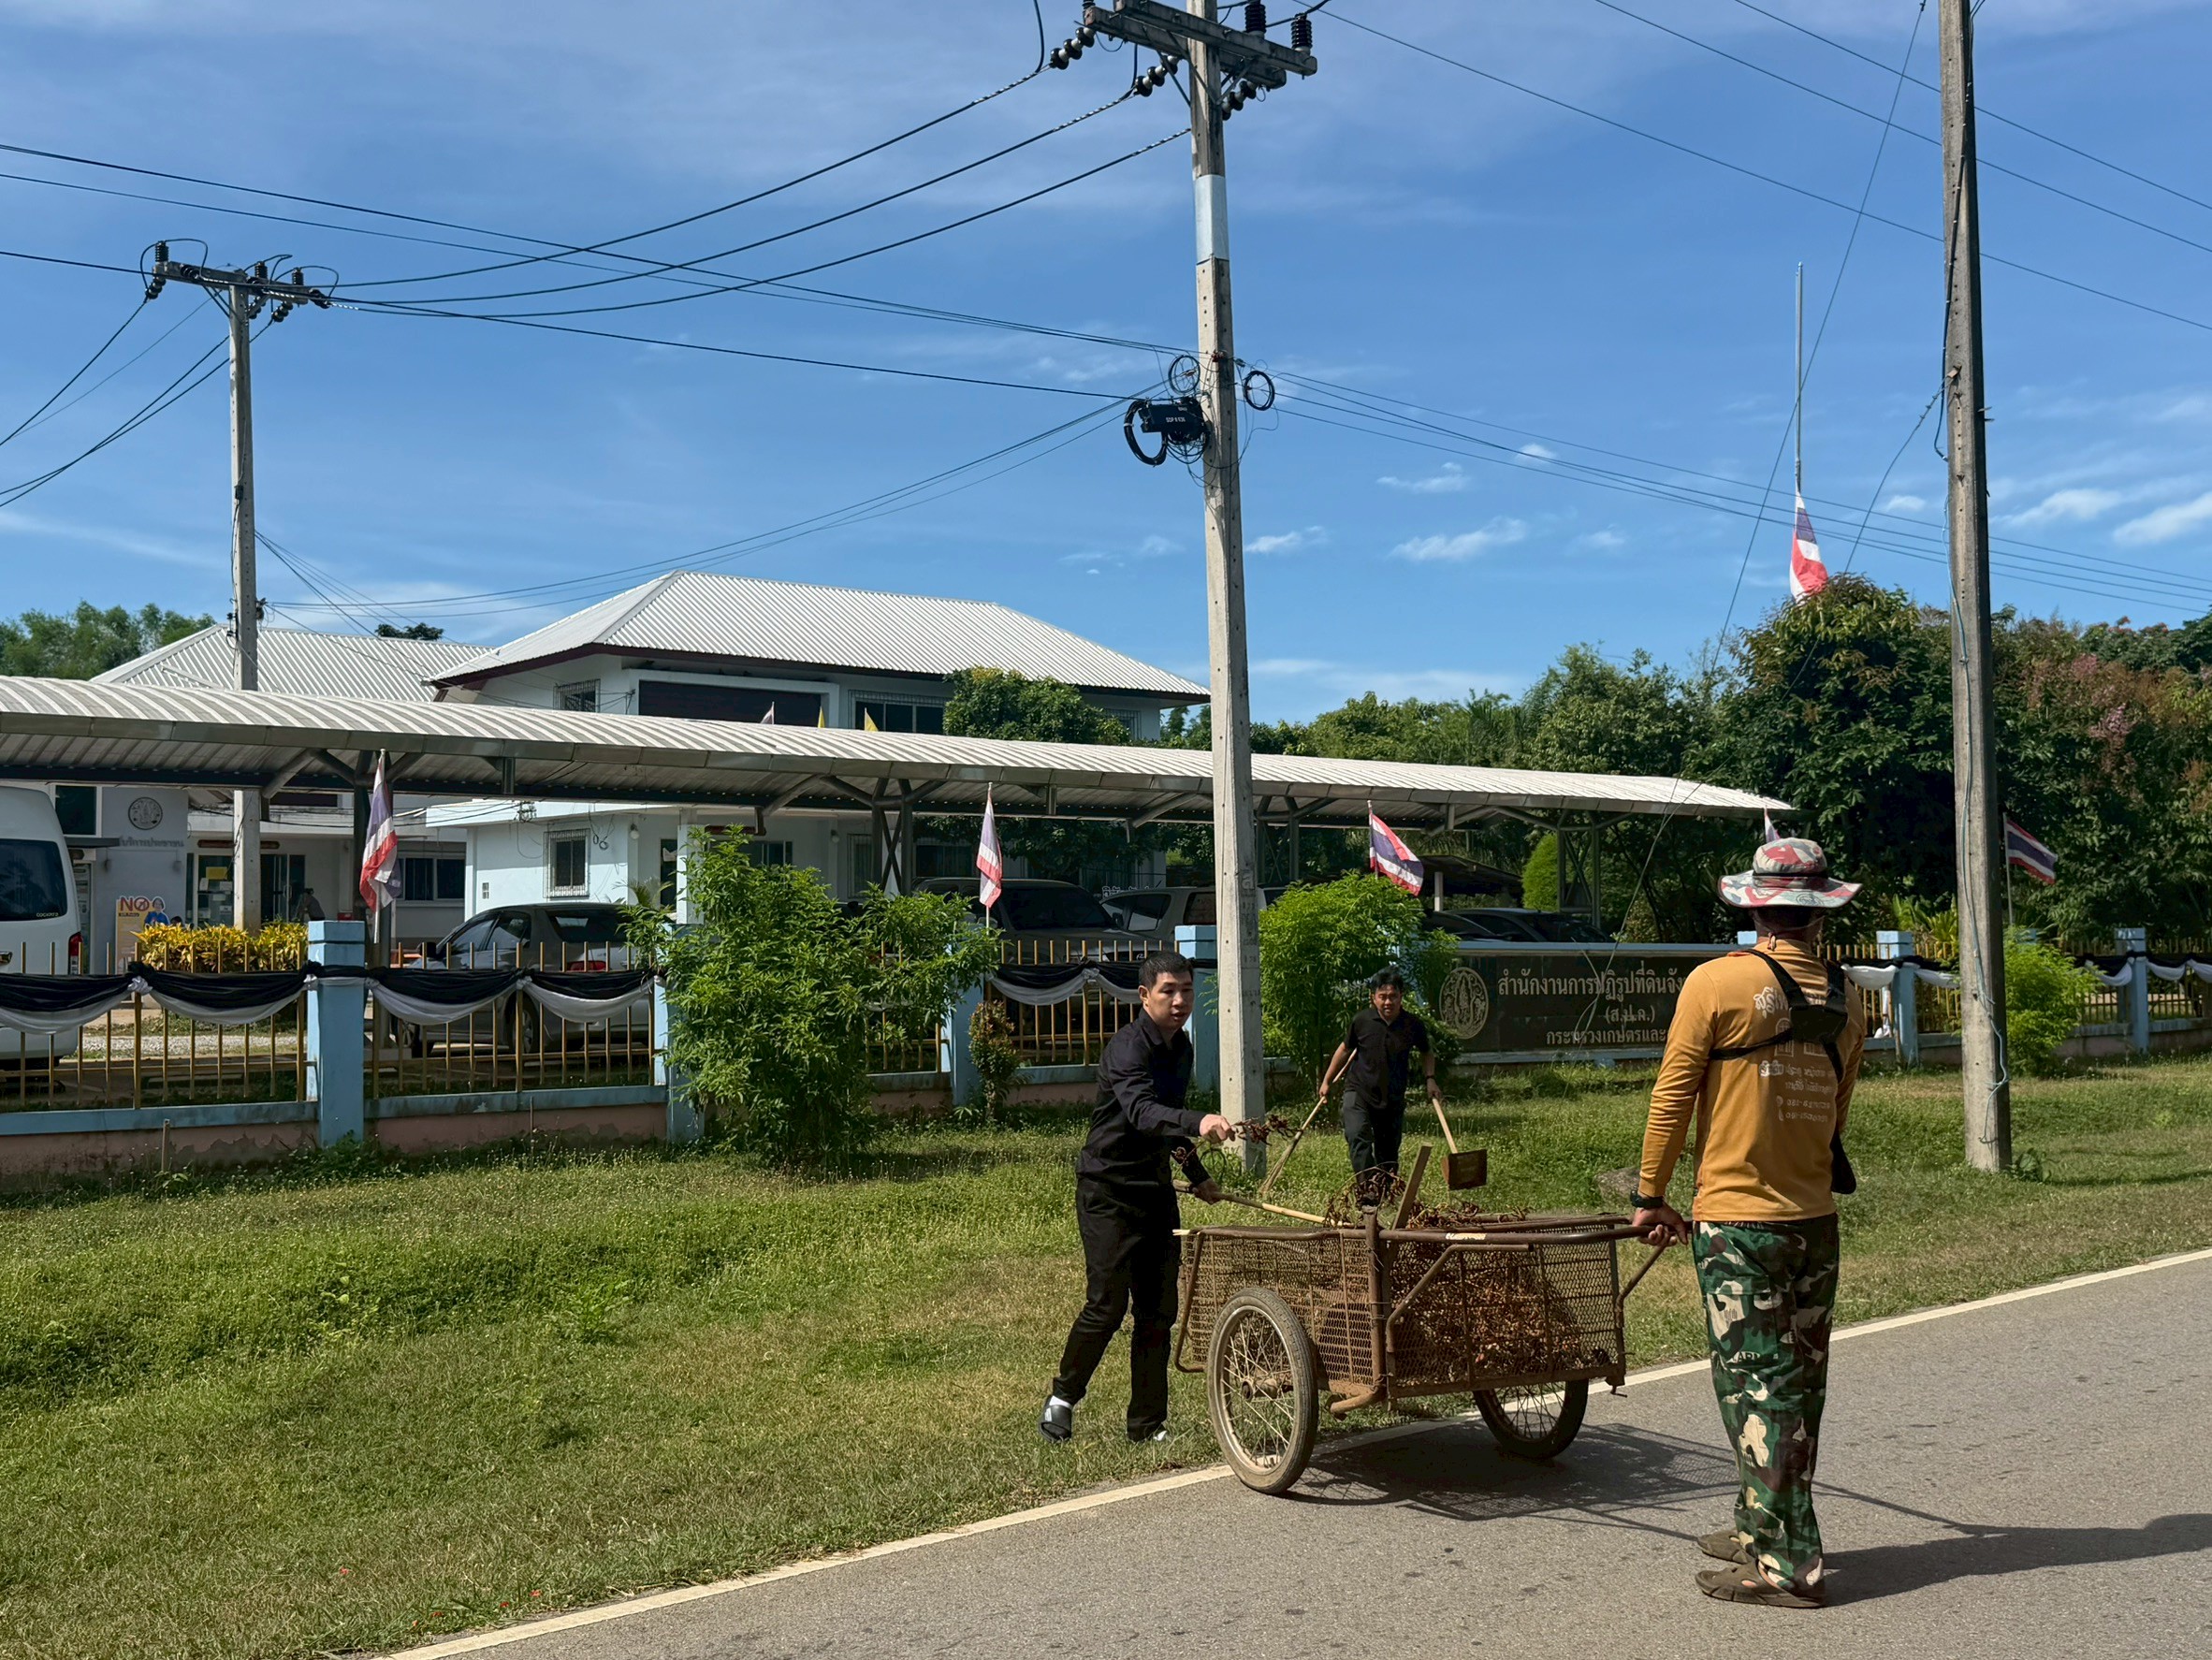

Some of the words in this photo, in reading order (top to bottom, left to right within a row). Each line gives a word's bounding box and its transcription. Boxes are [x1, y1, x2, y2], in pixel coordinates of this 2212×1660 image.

[1498, 960, 1684, 1002] สำนักงานการปฏิรูปที่ดินจัง
[1547, 1028, 1666, 1044] กระทรวงเกษตรและ
